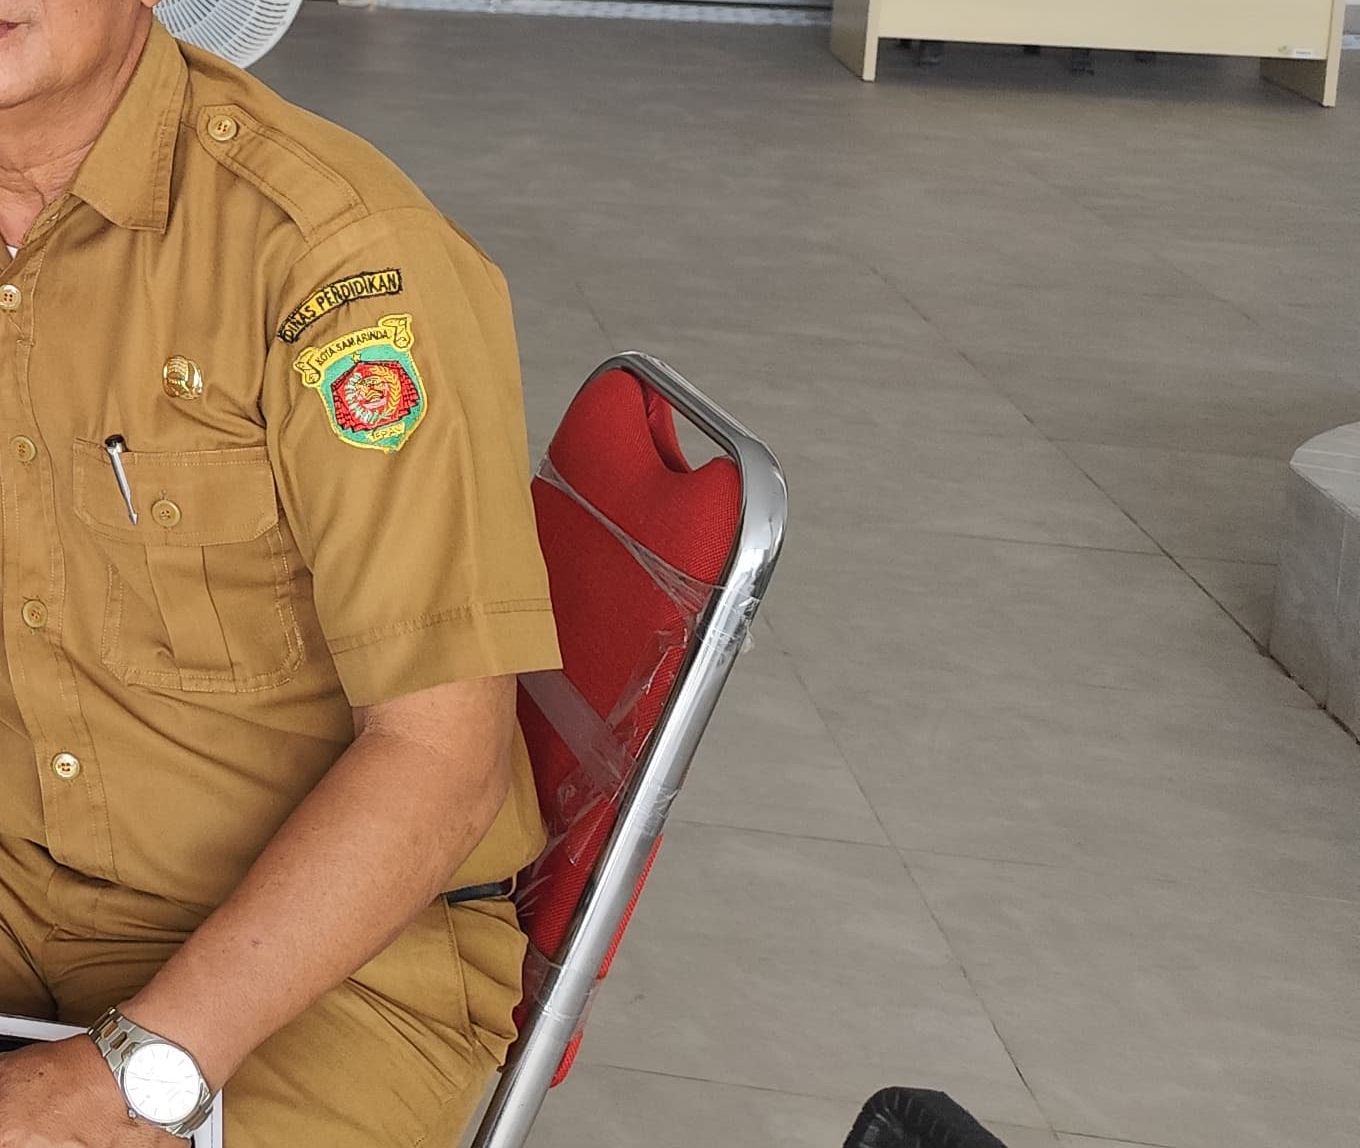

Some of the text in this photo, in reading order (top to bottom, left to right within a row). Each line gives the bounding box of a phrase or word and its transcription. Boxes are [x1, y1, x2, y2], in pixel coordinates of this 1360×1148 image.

[284, 273, 397, 341] DINAS PENDIDIKAN
[315, 329, 389, 365] KOTA SAMARINDA
